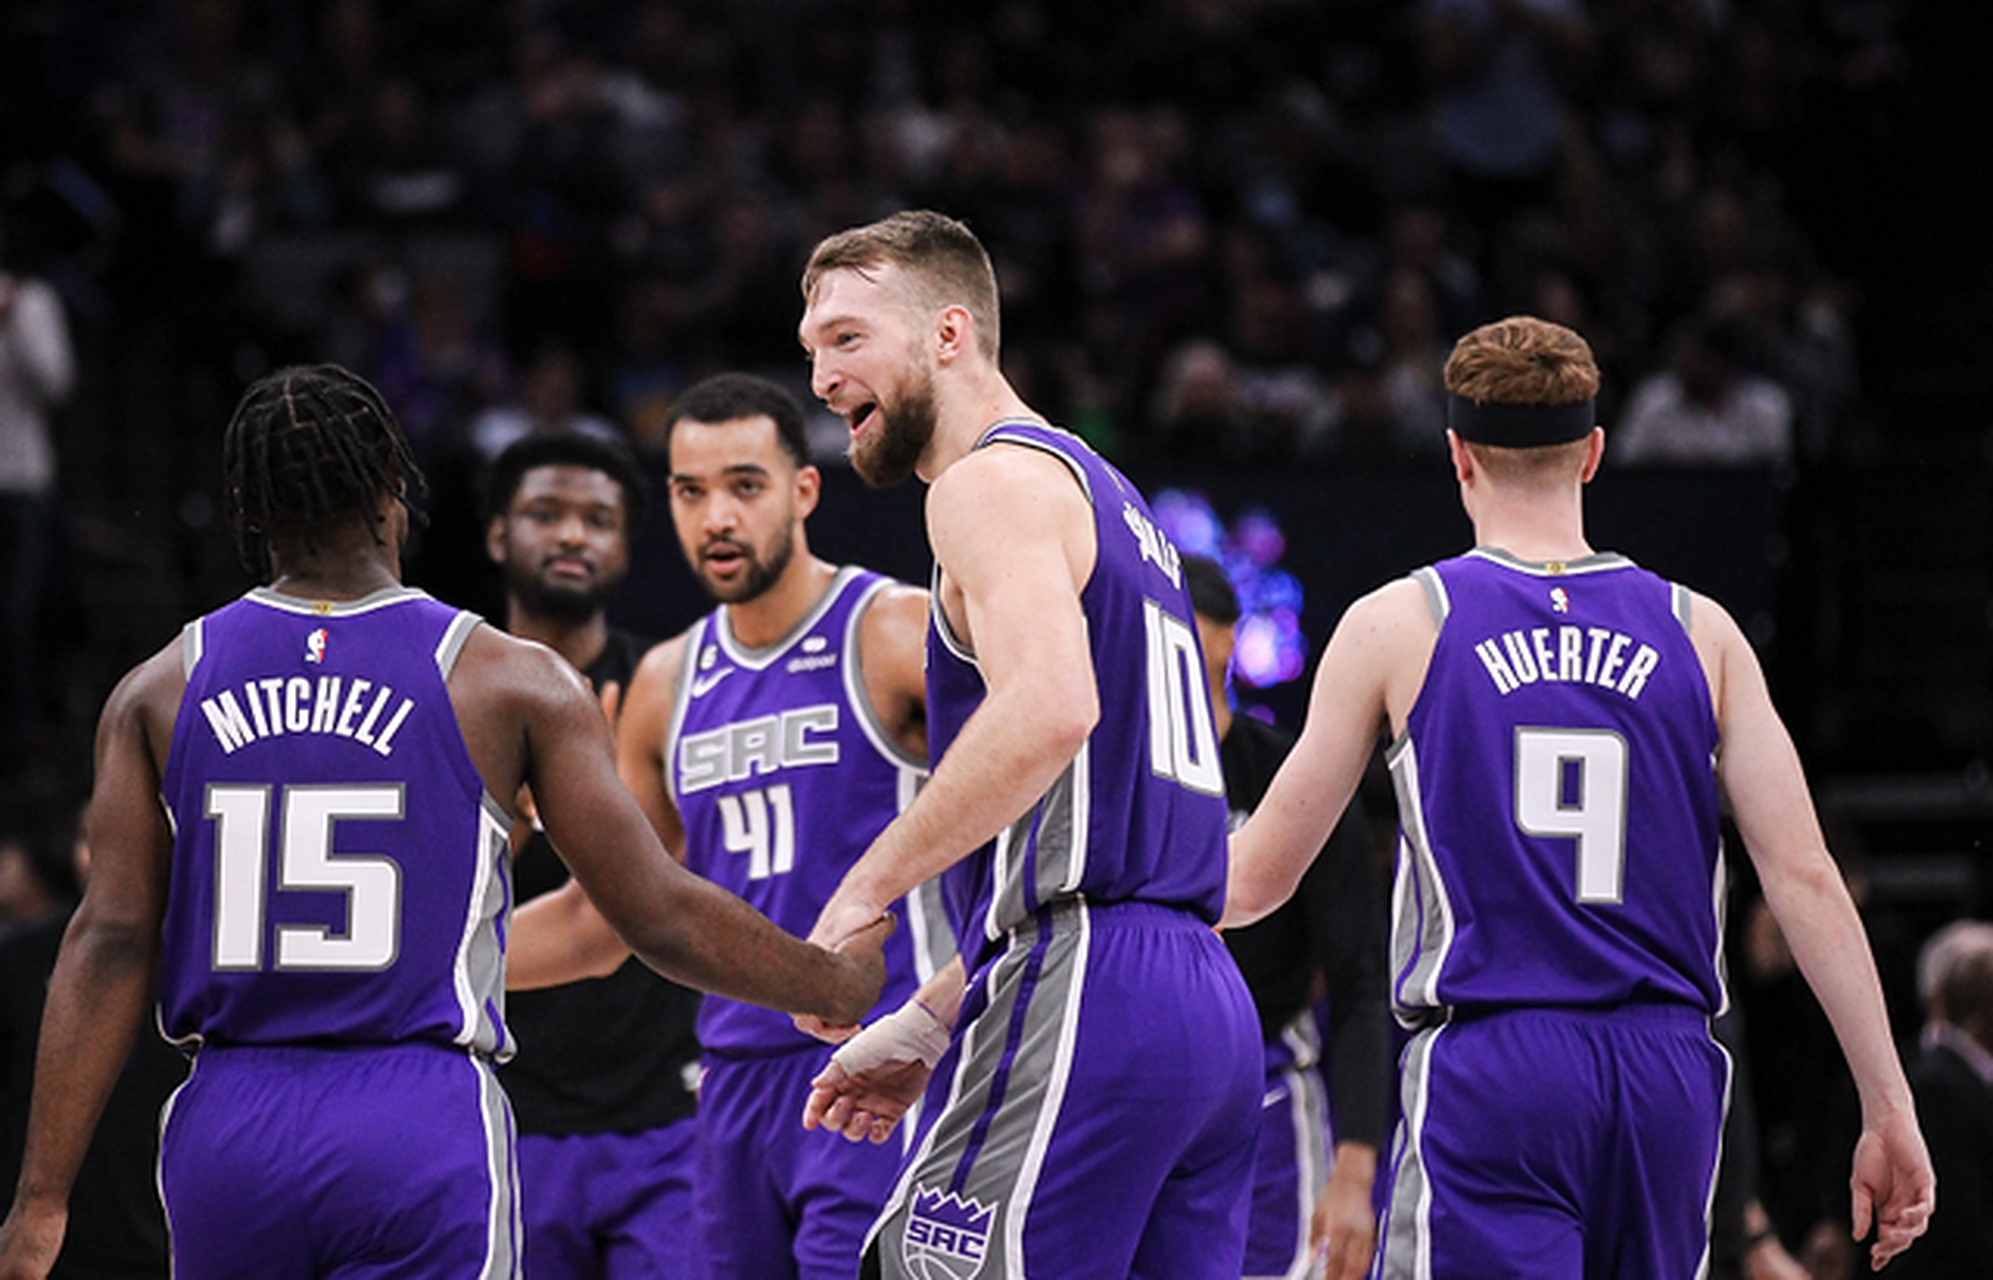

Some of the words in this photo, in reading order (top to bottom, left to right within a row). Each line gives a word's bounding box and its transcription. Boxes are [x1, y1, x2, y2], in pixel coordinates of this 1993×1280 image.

[1143, 596, 1225, 797] 10
[1475, 626, 1660, 699] HUERTER
[201, 677, 414, 755] MITCHELL
[680, 704, 839, 795] SAC
[718, 784, 795, 880] 41
[1514, 725, 1629, 904] 9
[205, 782, 405, 971] 15
[906, 1218, 986, 1260] SAC
